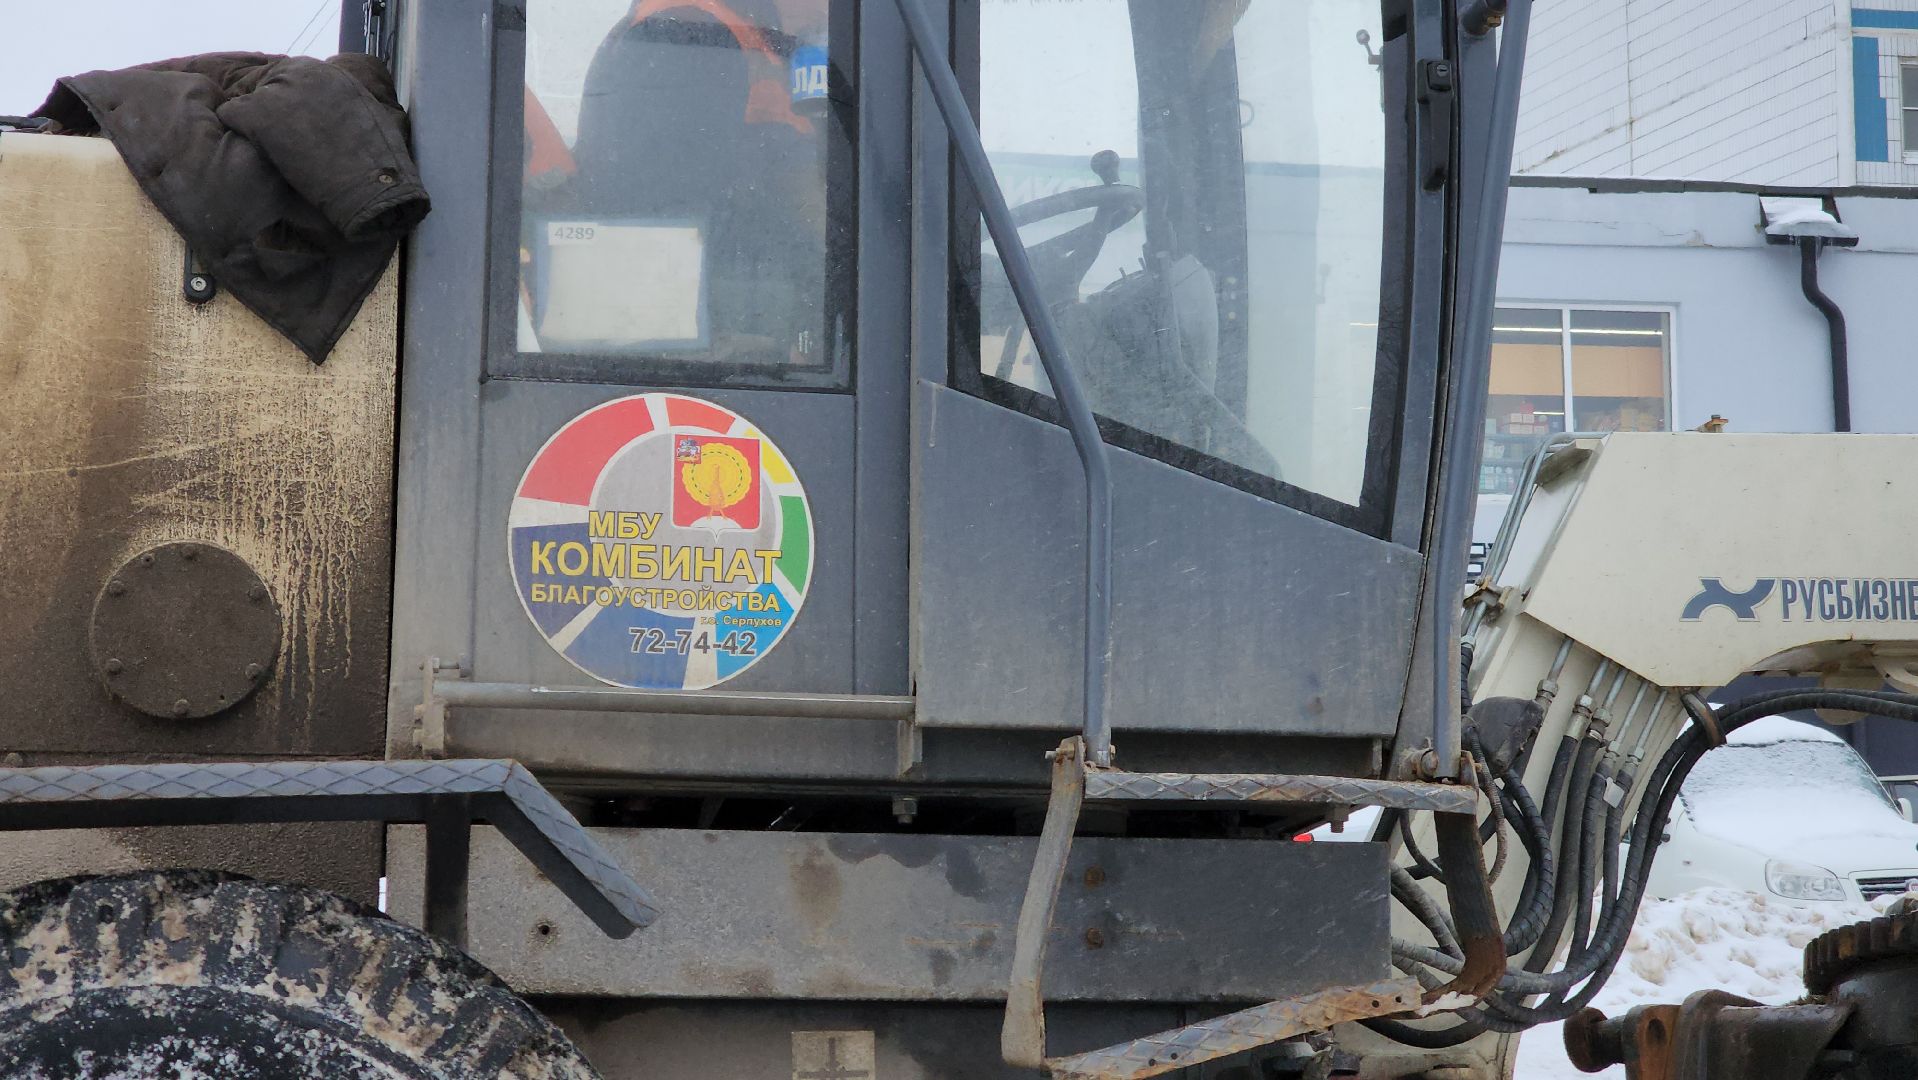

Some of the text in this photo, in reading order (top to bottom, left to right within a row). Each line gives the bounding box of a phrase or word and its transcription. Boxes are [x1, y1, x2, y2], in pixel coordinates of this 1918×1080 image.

[554, 227, 594, 240] 4289
[588, 510, 663, 541] МБУ
[530, 541, 783, 586] КОМБИНАТ
[530, 583, 781, 613] БЛАГОУСТРОЙСТВА
[1780, 578, 1918, 621] РУСБИЗНЕ
[723, 615, 782, 627] Серпухов
[629, 627, 757, 656] 72-74-42
